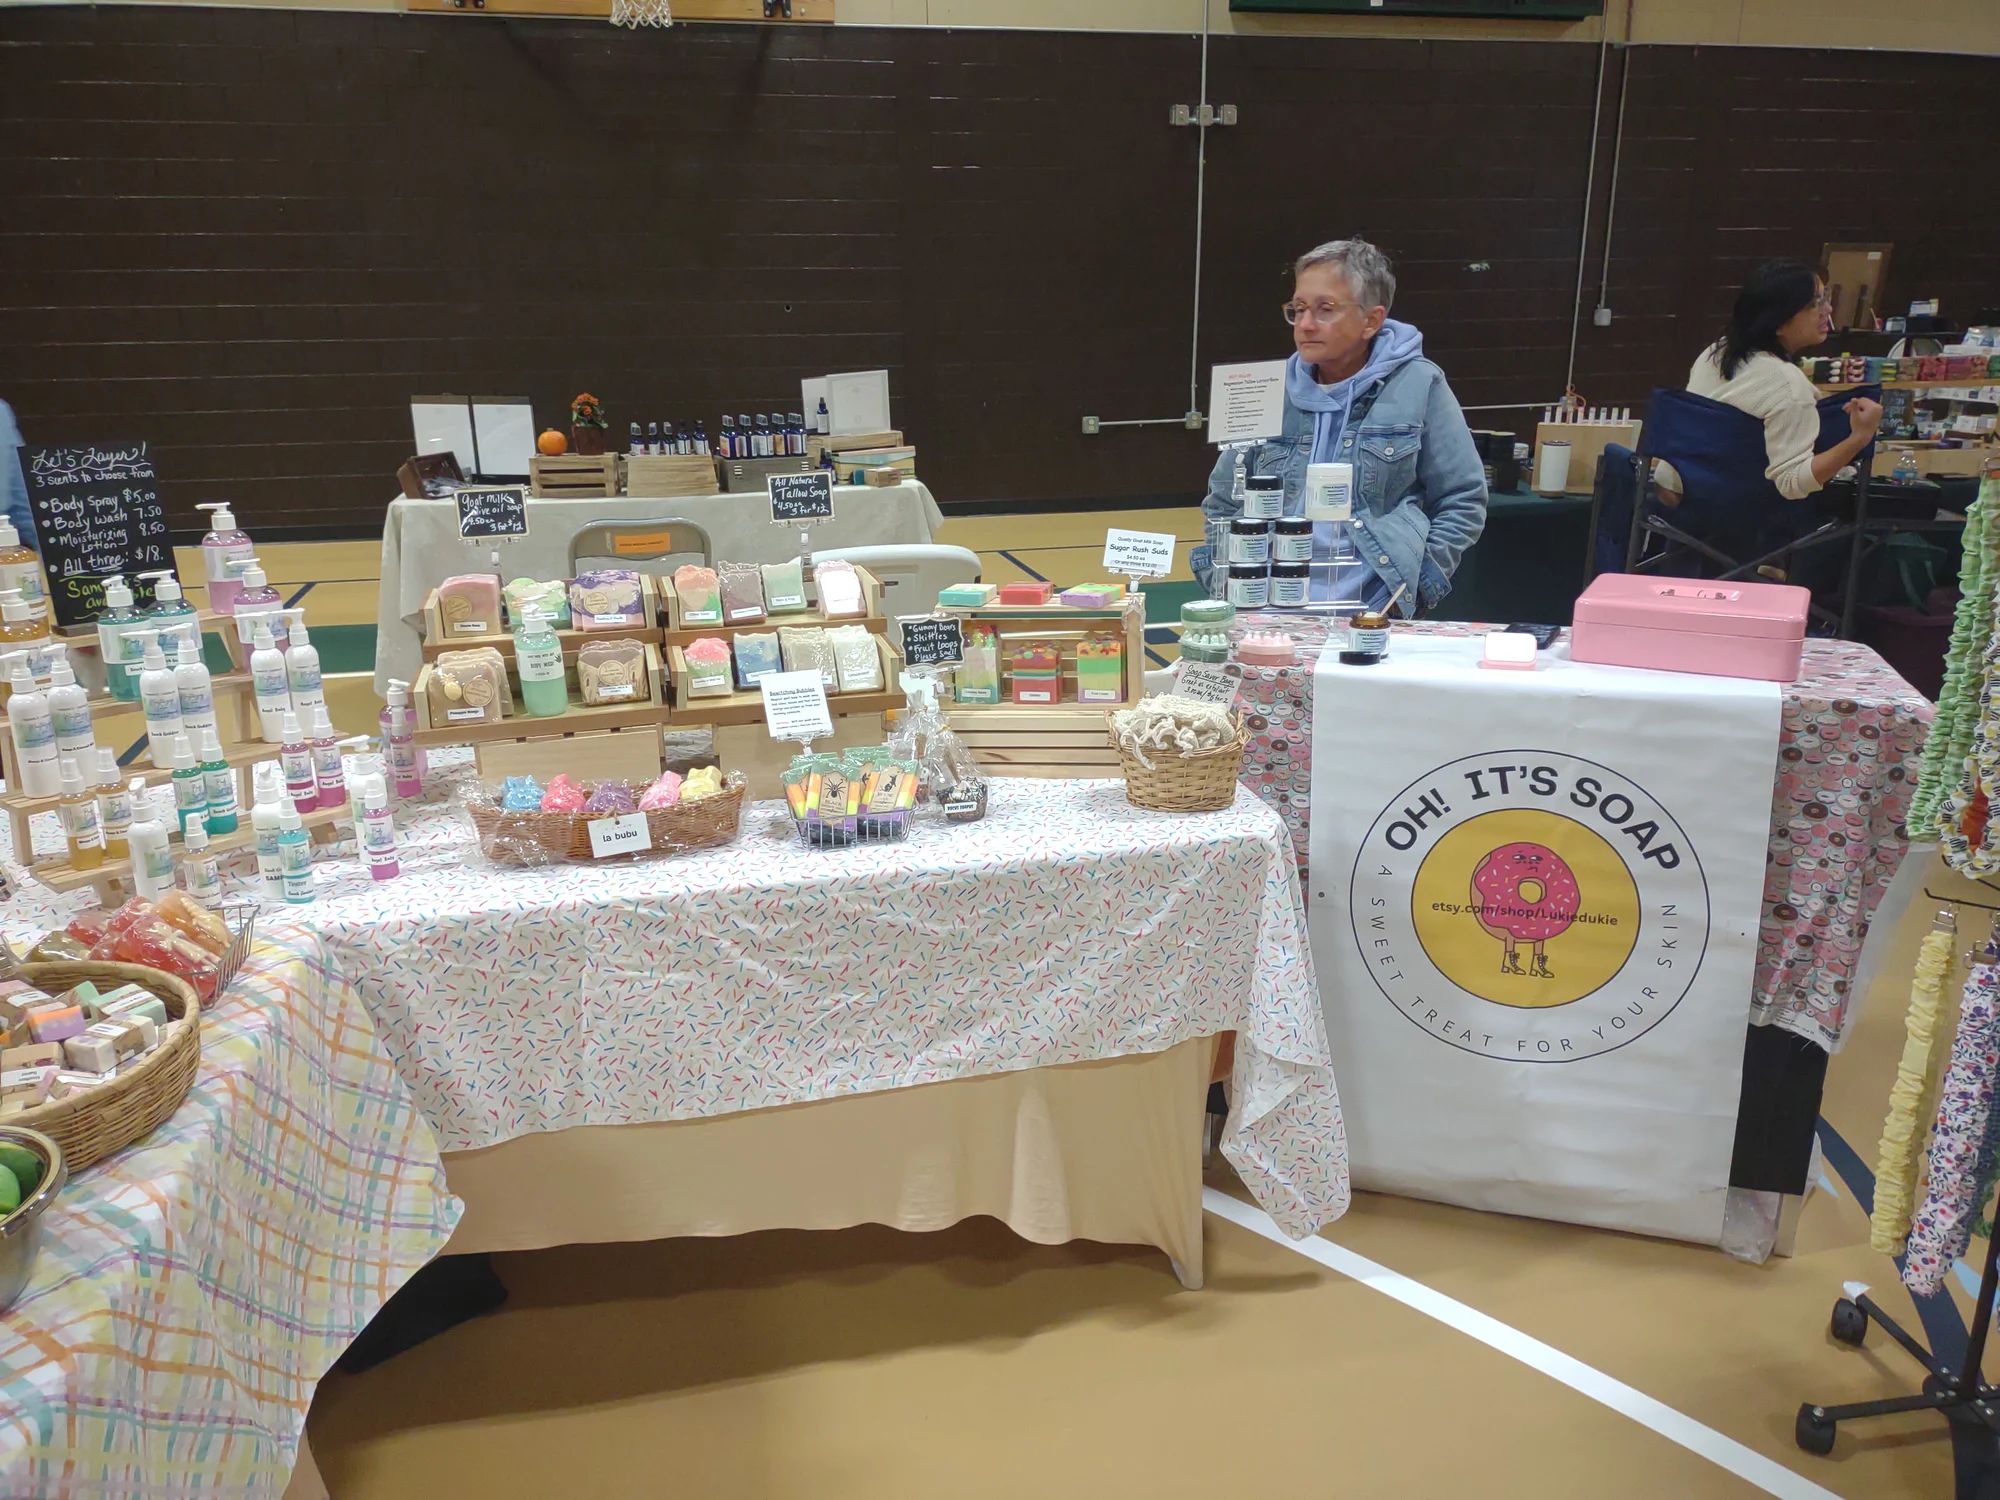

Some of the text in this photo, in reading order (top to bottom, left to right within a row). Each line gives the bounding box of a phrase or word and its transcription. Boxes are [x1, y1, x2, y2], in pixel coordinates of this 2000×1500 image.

[32, 441, 147, 471] Let's Layer!
[36, 465, 154, 487] 3 scents to choose from
[774, 475, 819, 487] All Natural
[775, 485, 828, 500] Tallow Soap
[50, 487, 156, 516] Body Spray $5.00
[491, 503, 504, 514] oil
[506, 504, 523, 514] soap
[799, 506, 812, 515] for
[54, 505, 162, 533] Body wash 7.50
[489, 523, 497, 532] 3
[497, 521, 509, 532] for
[59, 522, 165, 547] Moisturizing 8.50
[81, 541, 118, 554] Lotion
[1109, 543, 1169, 556] Sugar Rush Suds
[63, 558, 84, 574] All
[912, 624, 938, 634] Gummy
[913, 631, 948, 642] Skittles
[913, 640, 958, 654] Fruit Loops
[1185, 664, 1203, 680] Soap
[1202, 670, 1220, 681] Saver
[1385, 765, 1681, 871] OH! IT'S SOAP
[602, 830, 638, 843] la bubu
[1431, 901, 1619, 926] etsy.com/shop/Lukiedukie
[1371, 864, 1678, 1053] A SWEET TREAT FOR YOUR SKIN
